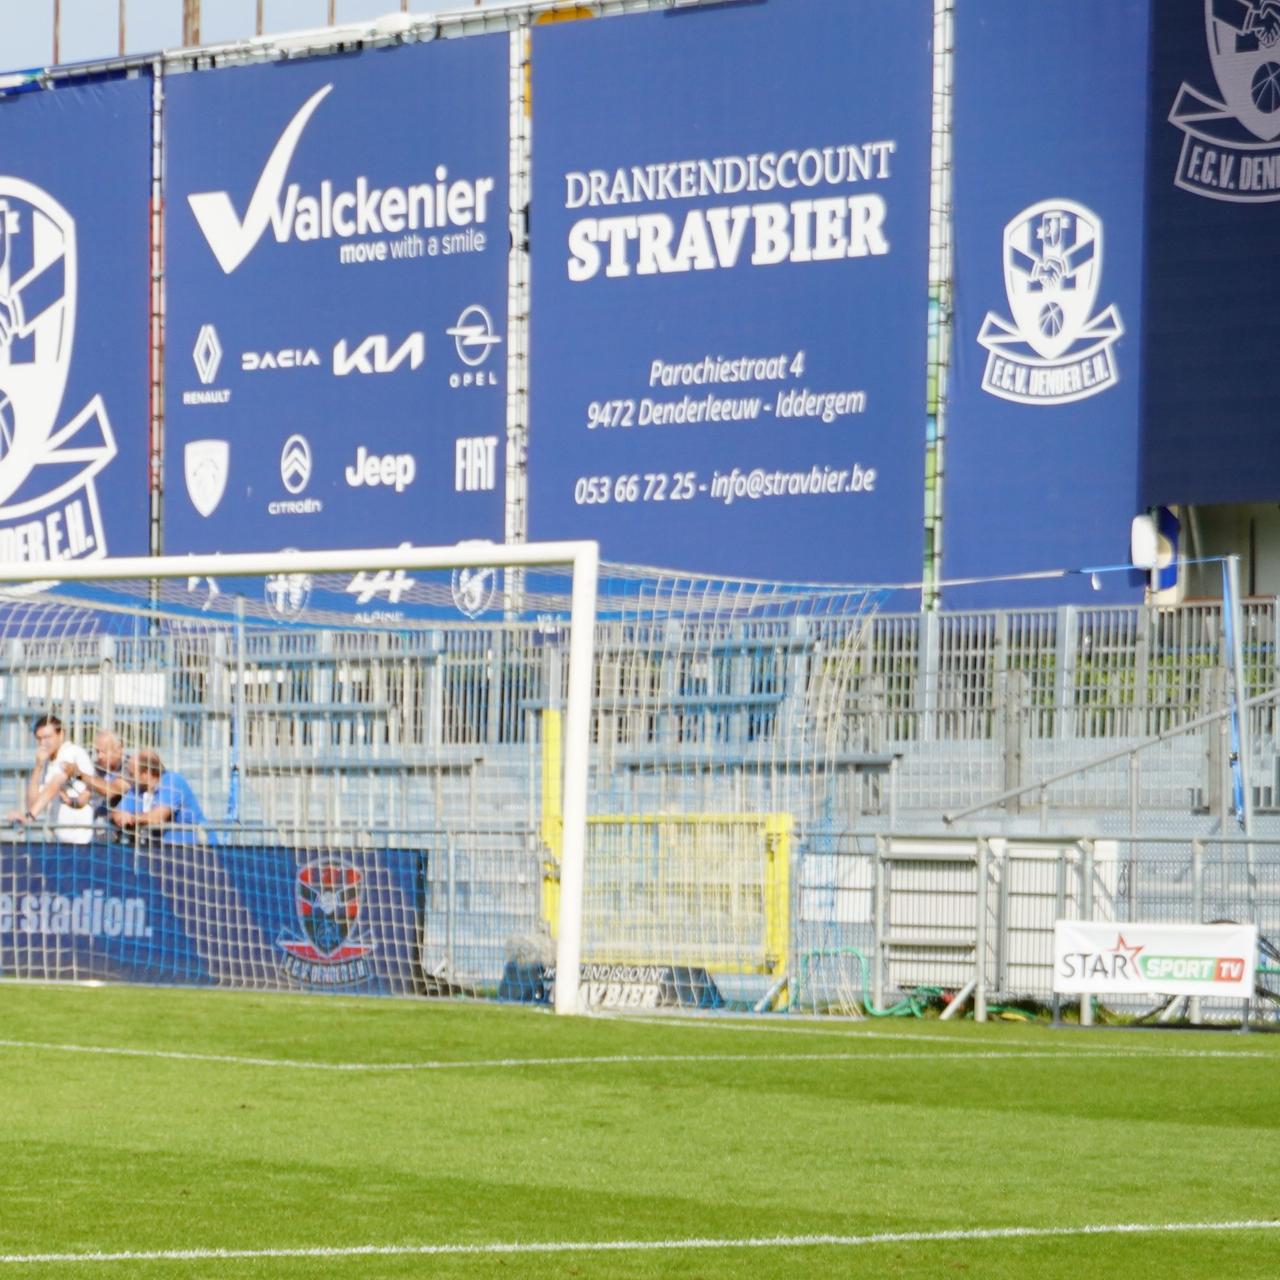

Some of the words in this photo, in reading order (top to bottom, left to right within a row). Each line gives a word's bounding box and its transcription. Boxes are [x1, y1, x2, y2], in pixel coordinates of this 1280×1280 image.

[565, 141, 895, 208] DRANKENDISCOUNT
[1187, 145, 1234, 190] F.C.V.
[271, 165, 494, 243] Valckenier
[341, 241, 386, 264] move
[390, 234, 423, 259] with
[428, 239, 438, 255] a
[443, 228, 486, 255] smile
[567, 194, 889, 281] STRAVBIER
[242, 349, 320, 370] DACIA
[333, 332, 425, 376] KIA
[649, 354, 787, 387] Parochiestraat
[790, 350, 805, 377] 4
[991, 357, 1027, 395] F.C.V.
[1028, 365, 1082, 396] DENDER
[1081, 353, 1109, 389] E.H.
[183, 390, 231, 405] RENAULT
[450, 372, 497, 388] OPEL
[587, 400, 634, 429] 9472
[638, 396, 760, 426] Denderleeuw
[775, 389, 866, 423] Iddergem
[345, 446, 415, 492] Jeep
[455, 437, 499, 491] FIAT
[574, 475, 610, 504] 053
[614, 474, 640, 503] 66
[643, 473, 669, 501] 72
[670, 471, 697, 500] 25
[710, 463, 877, 504] info@stravbier.be
[46, 499, 95, 561] E.H.
[20, 889, 153, 938] stadion.
[1062, 953, 1129, 980] STAR
[1146, 957, 1214, 979] SPORT
[1219, 961, 1242, 979] TV
